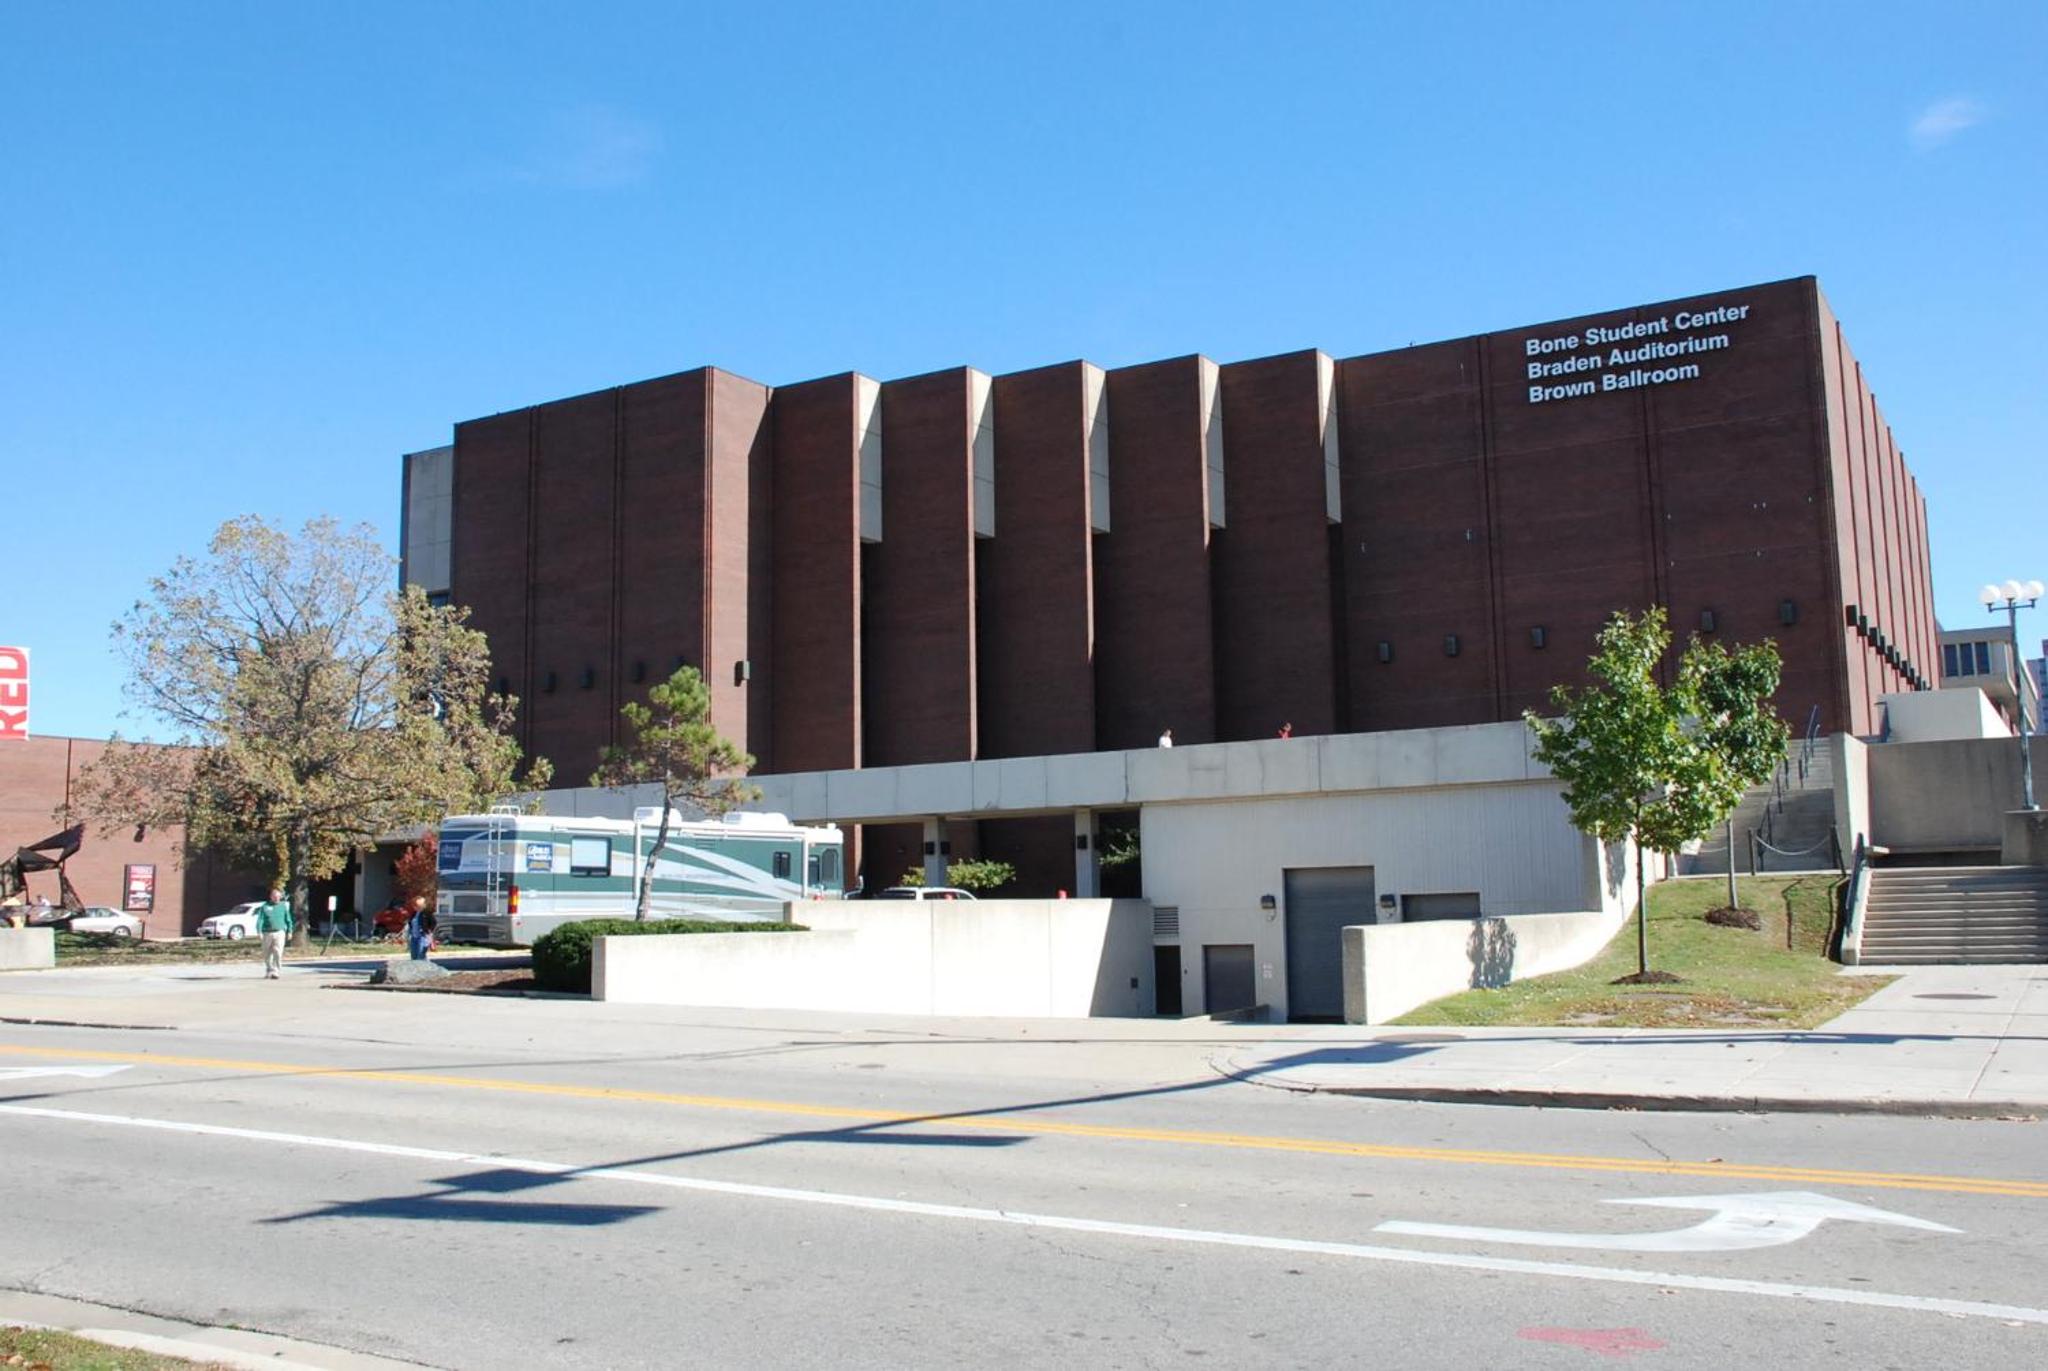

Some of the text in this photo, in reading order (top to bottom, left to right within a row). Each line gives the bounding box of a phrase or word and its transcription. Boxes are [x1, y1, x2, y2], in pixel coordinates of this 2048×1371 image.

[1526, 304, 1750, 355] Bone Student Center
[1527, 334, 1730, 379] Braden Auditorium
[1529, 363, 1700, 403] Brown Ballroom
